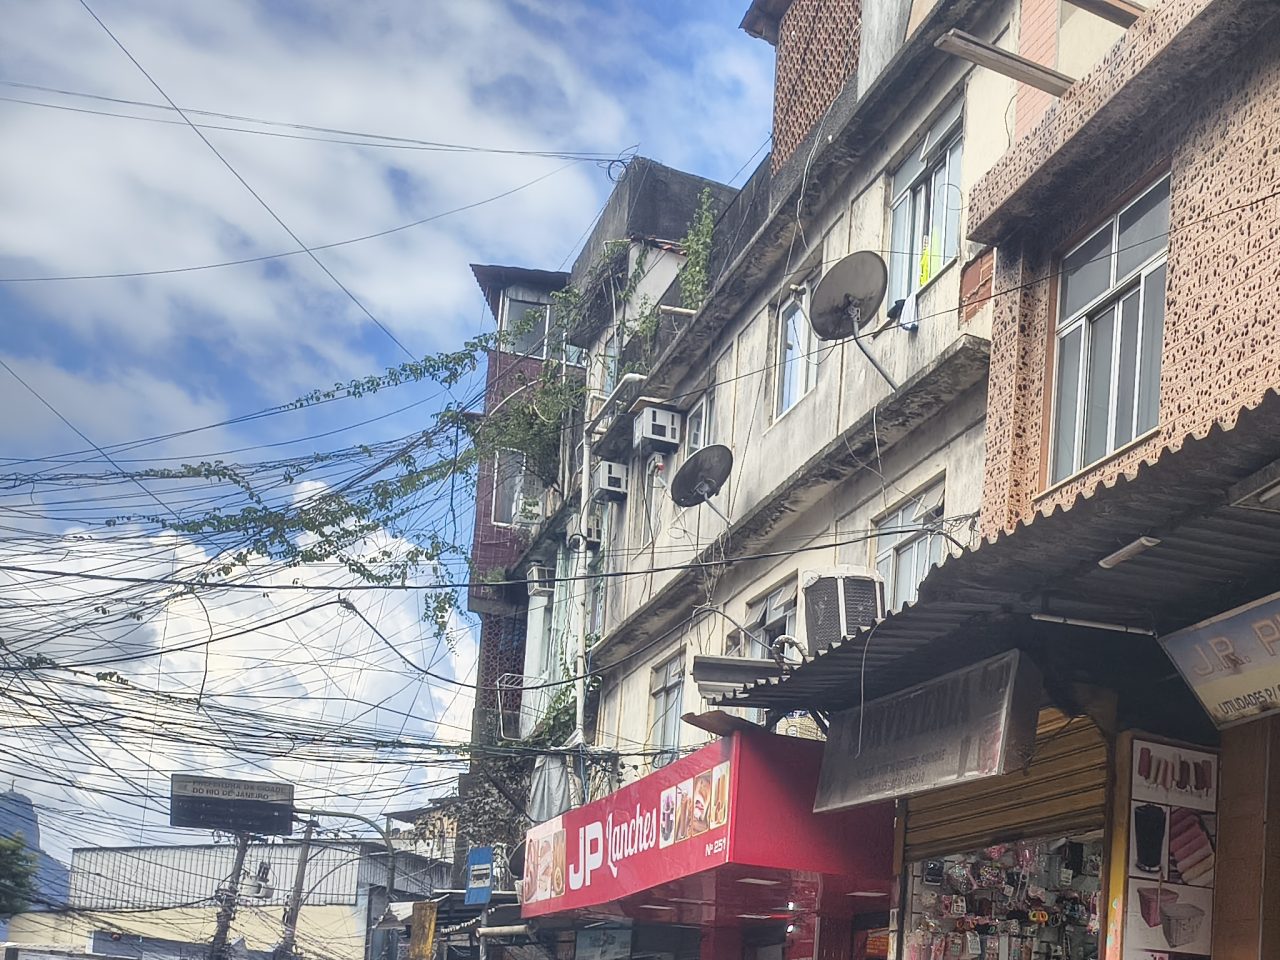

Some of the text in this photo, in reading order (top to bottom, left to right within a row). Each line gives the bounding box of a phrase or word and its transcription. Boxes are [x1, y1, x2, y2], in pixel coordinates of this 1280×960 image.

[1218, 690, 1269, 715] UTILIDADES
[206, 788, 220, 796] RIO
[222, 789, 234, 797] DE
[236, 791, 269, 800] JANEIRO
[568, 803, 657, 890] JP Lanches
[713, 837, 727, 854] 251
